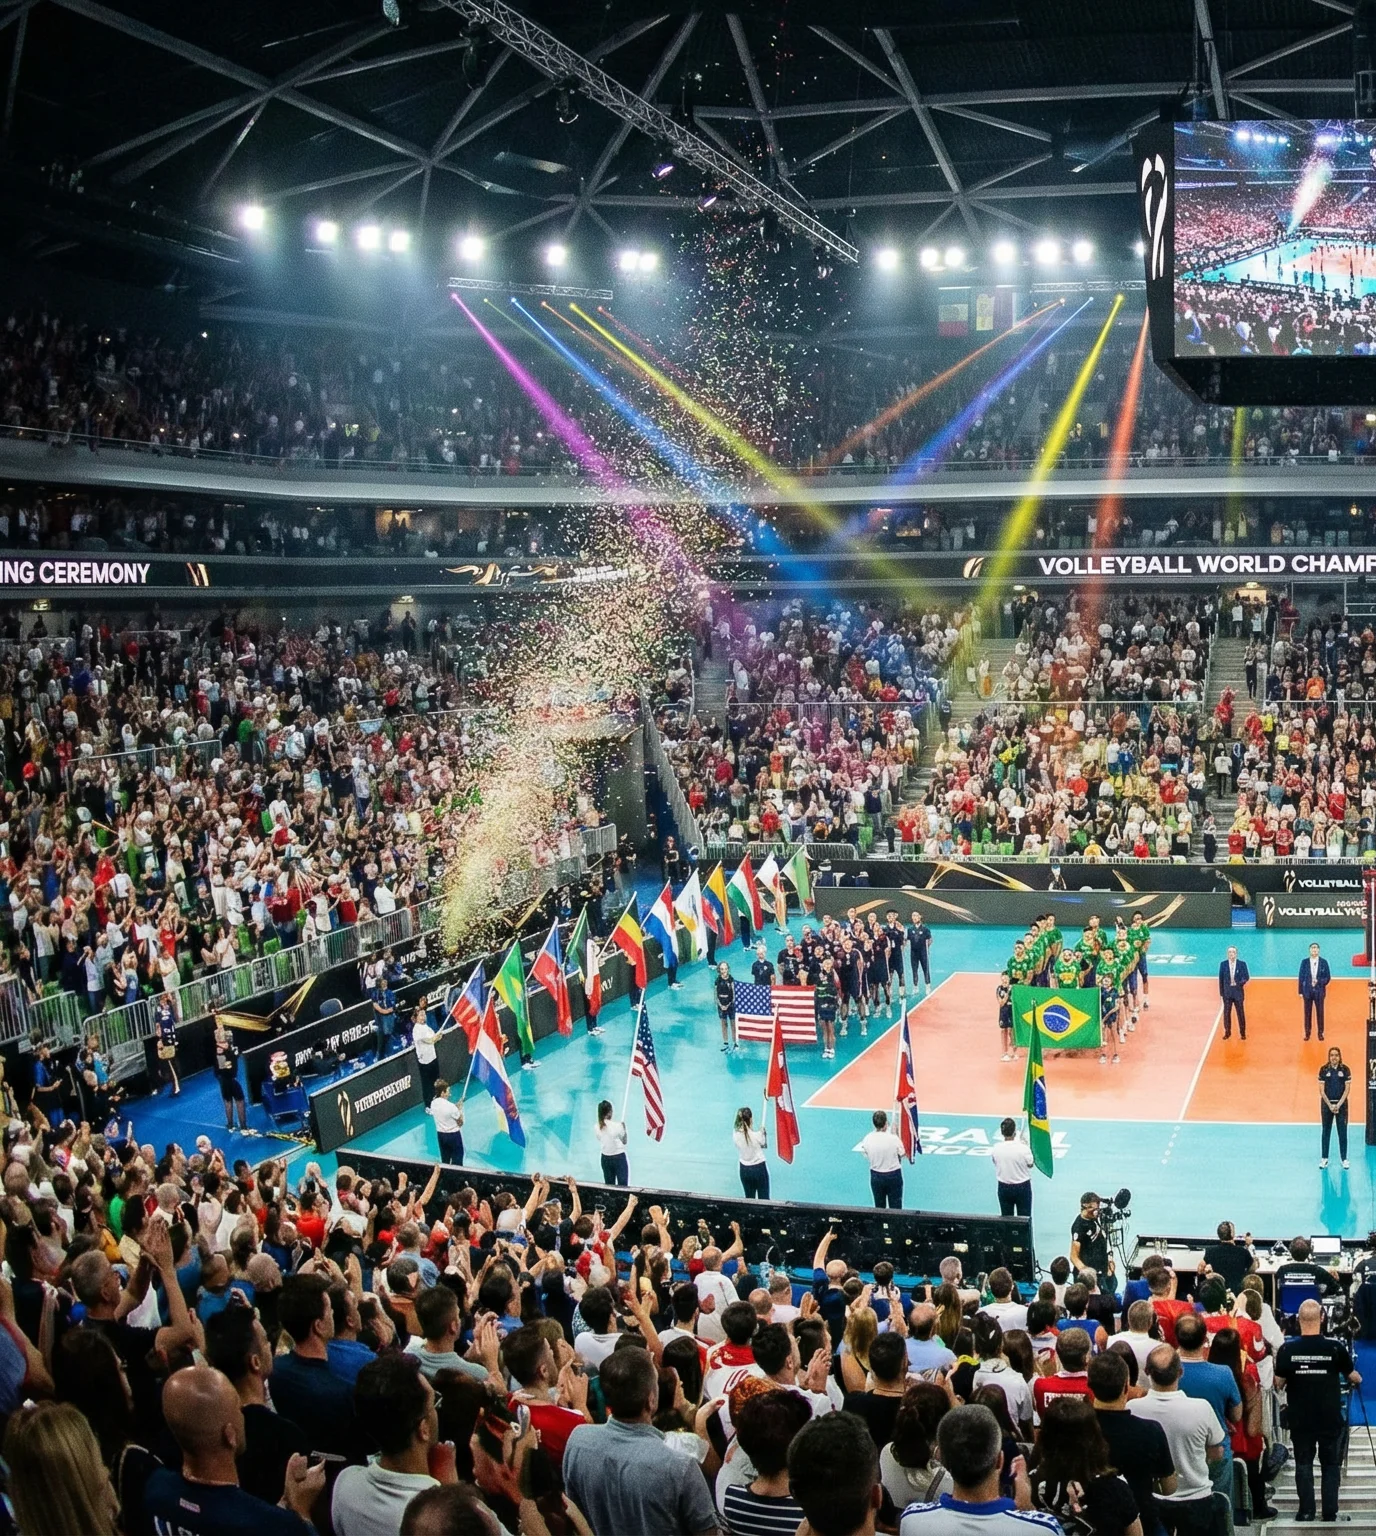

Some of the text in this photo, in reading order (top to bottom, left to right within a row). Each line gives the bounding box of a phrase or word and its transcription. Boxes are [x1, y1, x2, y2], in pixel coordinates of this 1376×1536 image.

[39, 562, 150, 584] CEREMONY
[1039, 557, 1192, 575] VOLLEYBALL
[1197, 555, 1286, 573] WORLD
